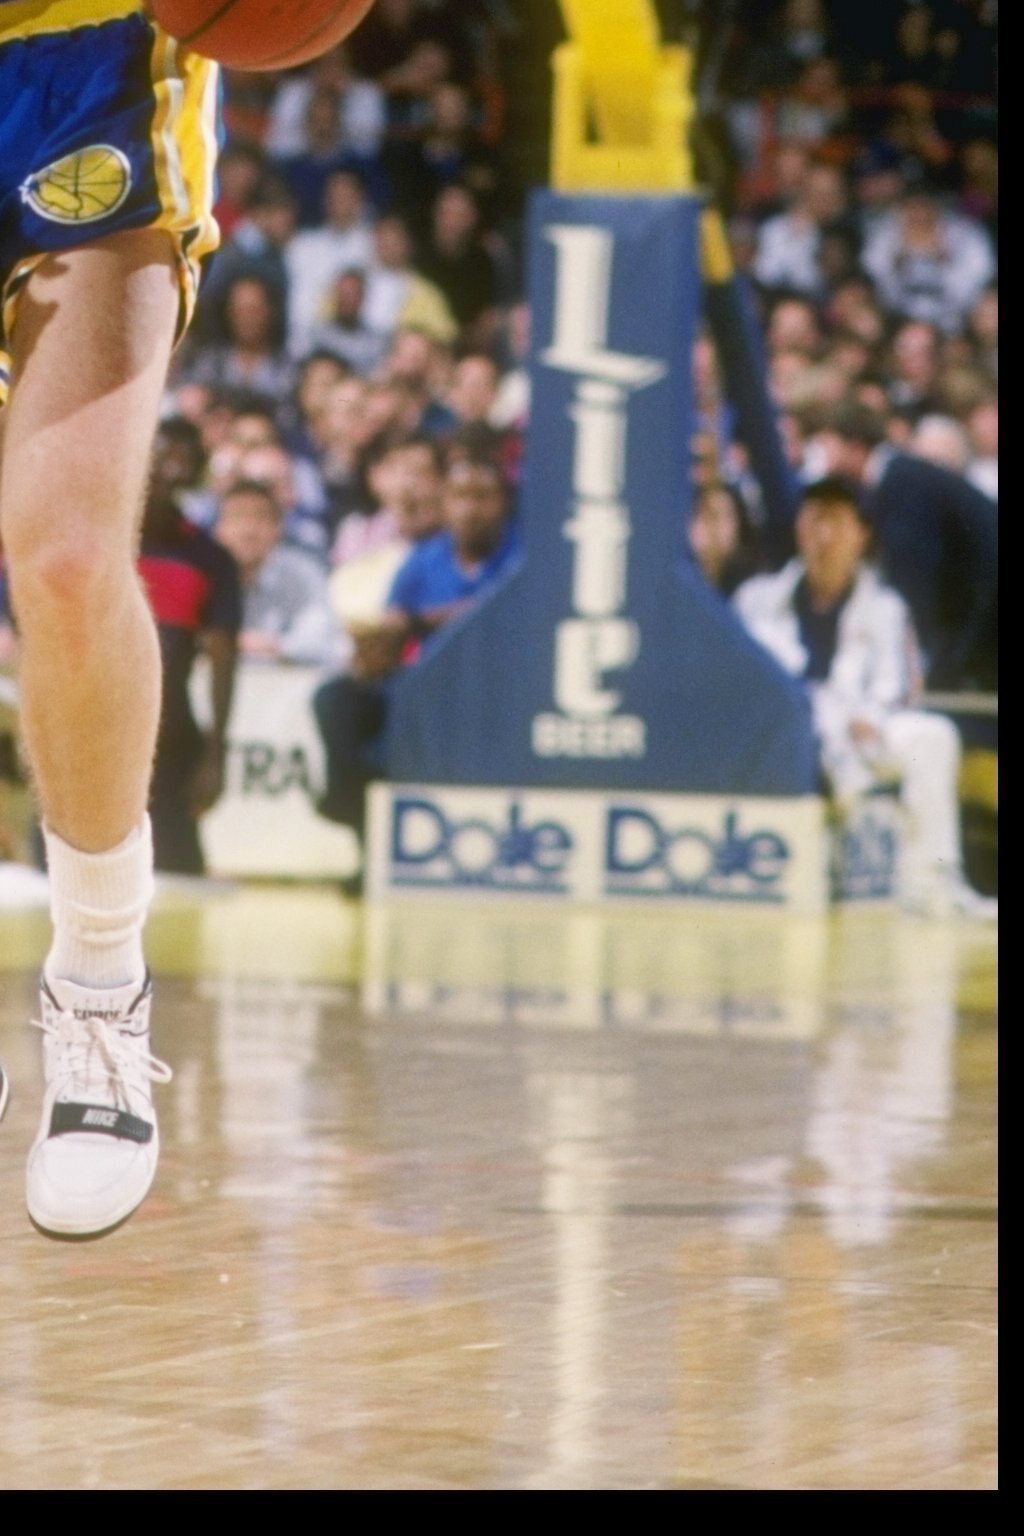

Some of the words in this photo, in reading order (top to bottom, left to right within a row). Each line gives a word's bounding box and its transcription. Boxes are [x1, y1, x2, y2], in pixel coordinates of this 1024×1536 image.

[531, 713, 648, 758] BEER
[392, 798, 574, 882] Dole
[605, 806, 791, 890] Dole
[81, 1107, 120, 1128] NIKE
